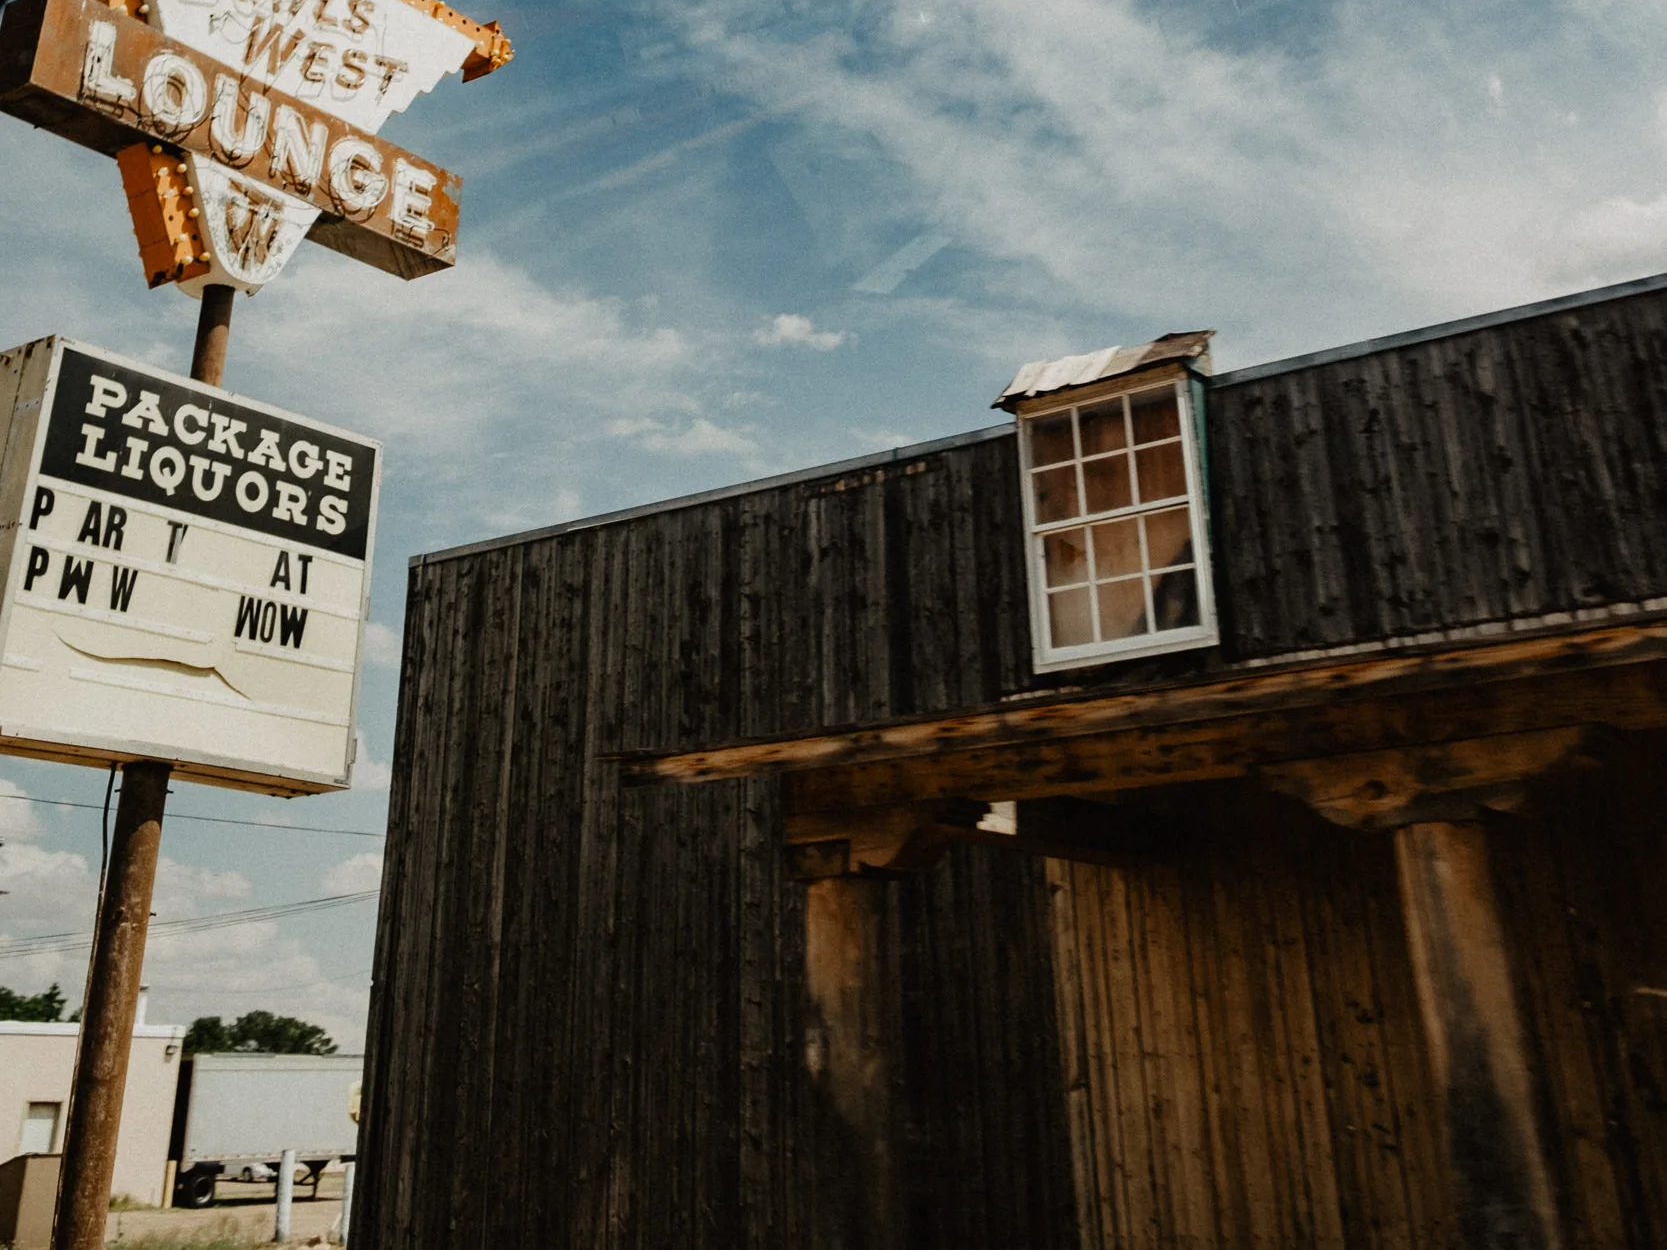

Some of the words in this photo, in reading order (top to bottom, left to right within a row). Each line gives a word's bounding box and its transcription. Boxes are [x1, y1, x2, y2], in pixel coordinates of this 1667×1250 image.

[243, 16, 410, 97] WEST
[82, 21, 437, 236] LOUNGE
[75, 423, 349, 536] LIQUORS
[85, 374, 353, 492] PACKAGE
[29, 485, 55, 530] P
[77, 500, 127, 551] AR
[270, 550, 313, 595] AT
[234, 595, 308, 649] WOW
